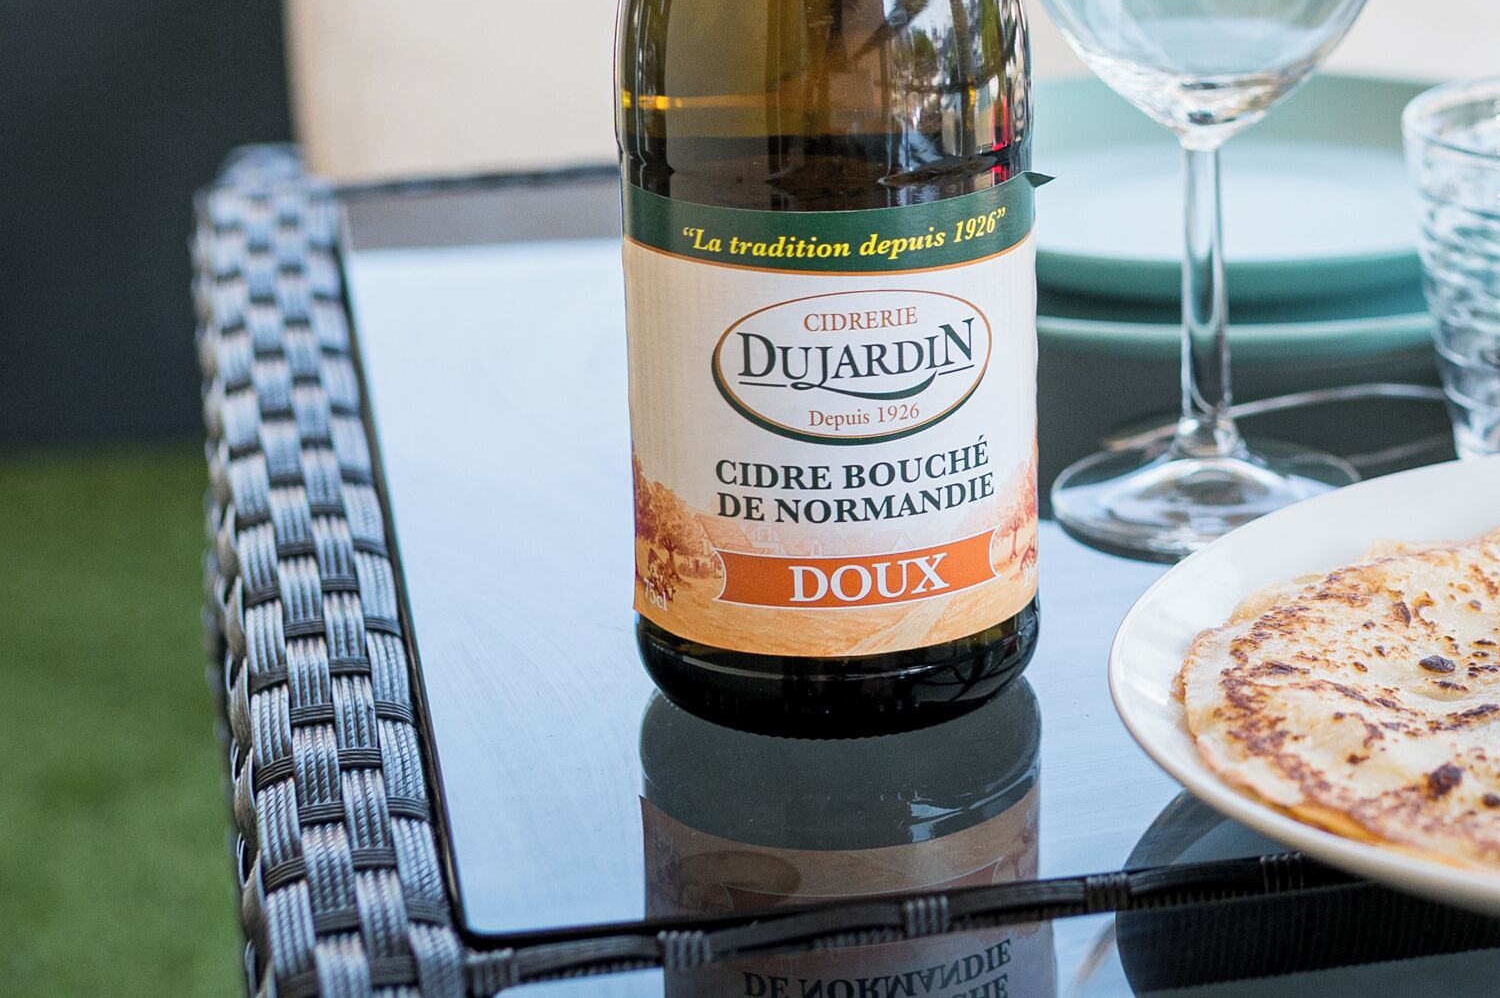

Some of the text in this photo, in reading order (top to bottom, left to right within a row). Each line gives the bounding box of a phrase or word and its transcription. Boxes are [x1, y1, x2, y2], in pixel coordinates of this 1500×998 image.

[729, 236, 852, 258] tradition
[859, 226, 946, 260] depuis
[803, 306, 918, 333] CIDRERIE
[737, 318, 975, 392] DUJARDIN
[809, 404, 919, 431] Depuis 1926
[715, 435, 989, 490] CIDRE BOUCHÉ
[717, 472, 995, 524] DE NORMANDIE
[789, 553, 950, 602] DOUX
